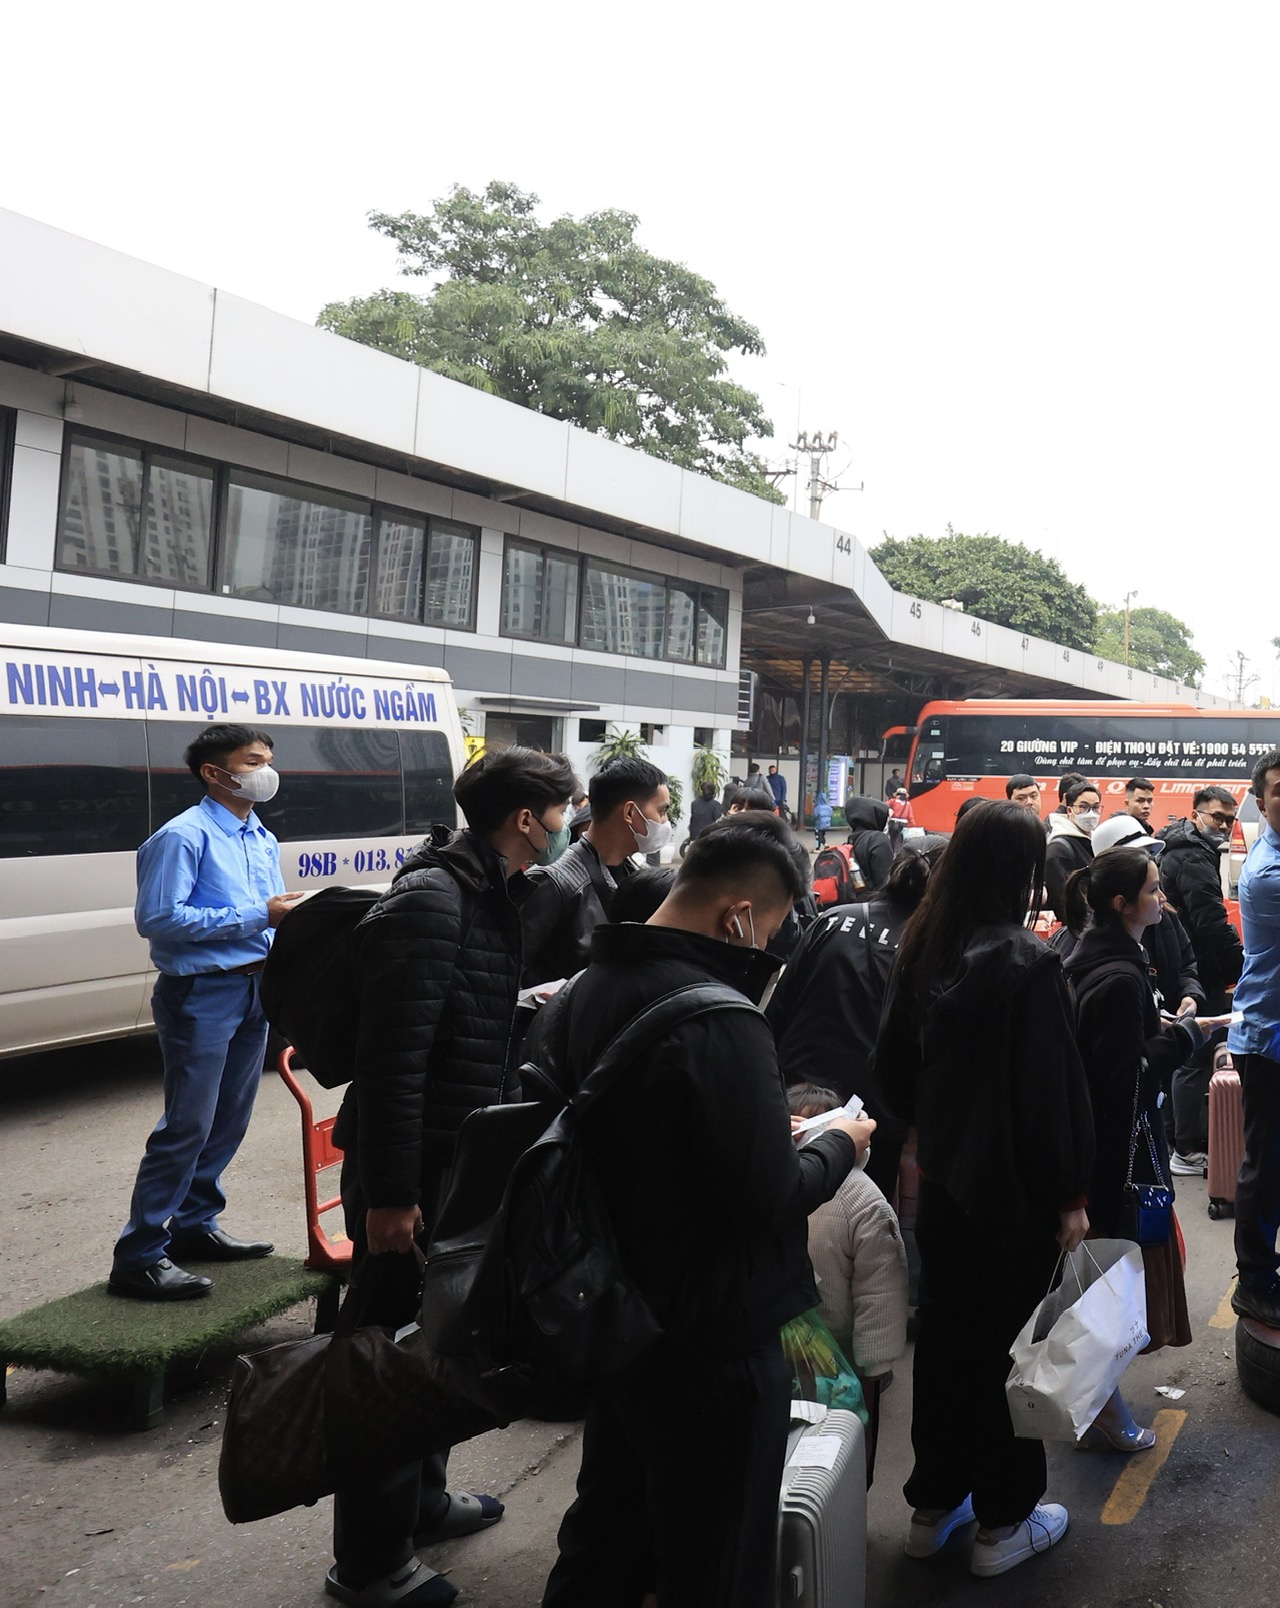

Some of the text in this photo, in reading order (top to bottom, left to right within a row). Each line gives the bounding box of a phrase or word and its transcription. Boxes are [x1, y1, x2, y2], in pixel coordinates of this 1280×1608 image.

[836, 535, 851, 555] 44
[910, 601, 922, 619] 45
[971, 621, 981, 636] 46
[6, 662, 438, 722] NINH HÀ NỘI BX NƯỚC NGẦM
[1000, 740, 1014, 752] 20
[1016, 737, 1057, 753] GIƯỜNG
[1060, 741, 1078, 753] VIP
[1231, 743, 1246, 755] 54
[298, 852, 337, 878] 98B
